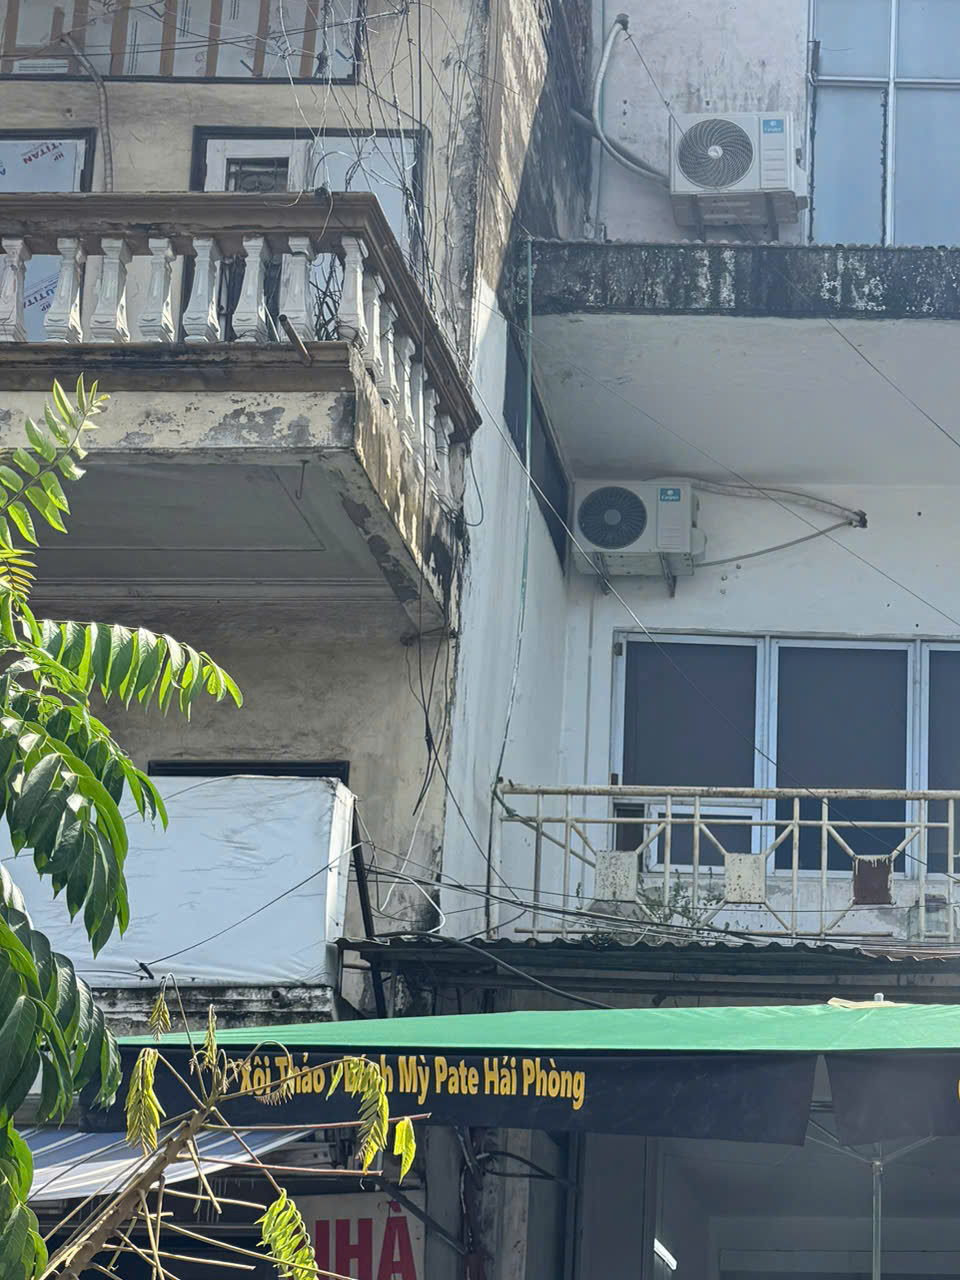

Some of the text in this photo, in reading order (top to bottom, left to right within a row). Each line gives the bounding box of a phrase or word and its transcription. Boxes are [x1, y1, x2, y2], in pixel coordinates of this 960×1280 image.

[23, 142, 62, 164] TITAN
[398, 1055, 430, 1105] Mỳ
[434, 1056, 479, 1094] Pate
[522, 1057, 585, 1110] Phòng
